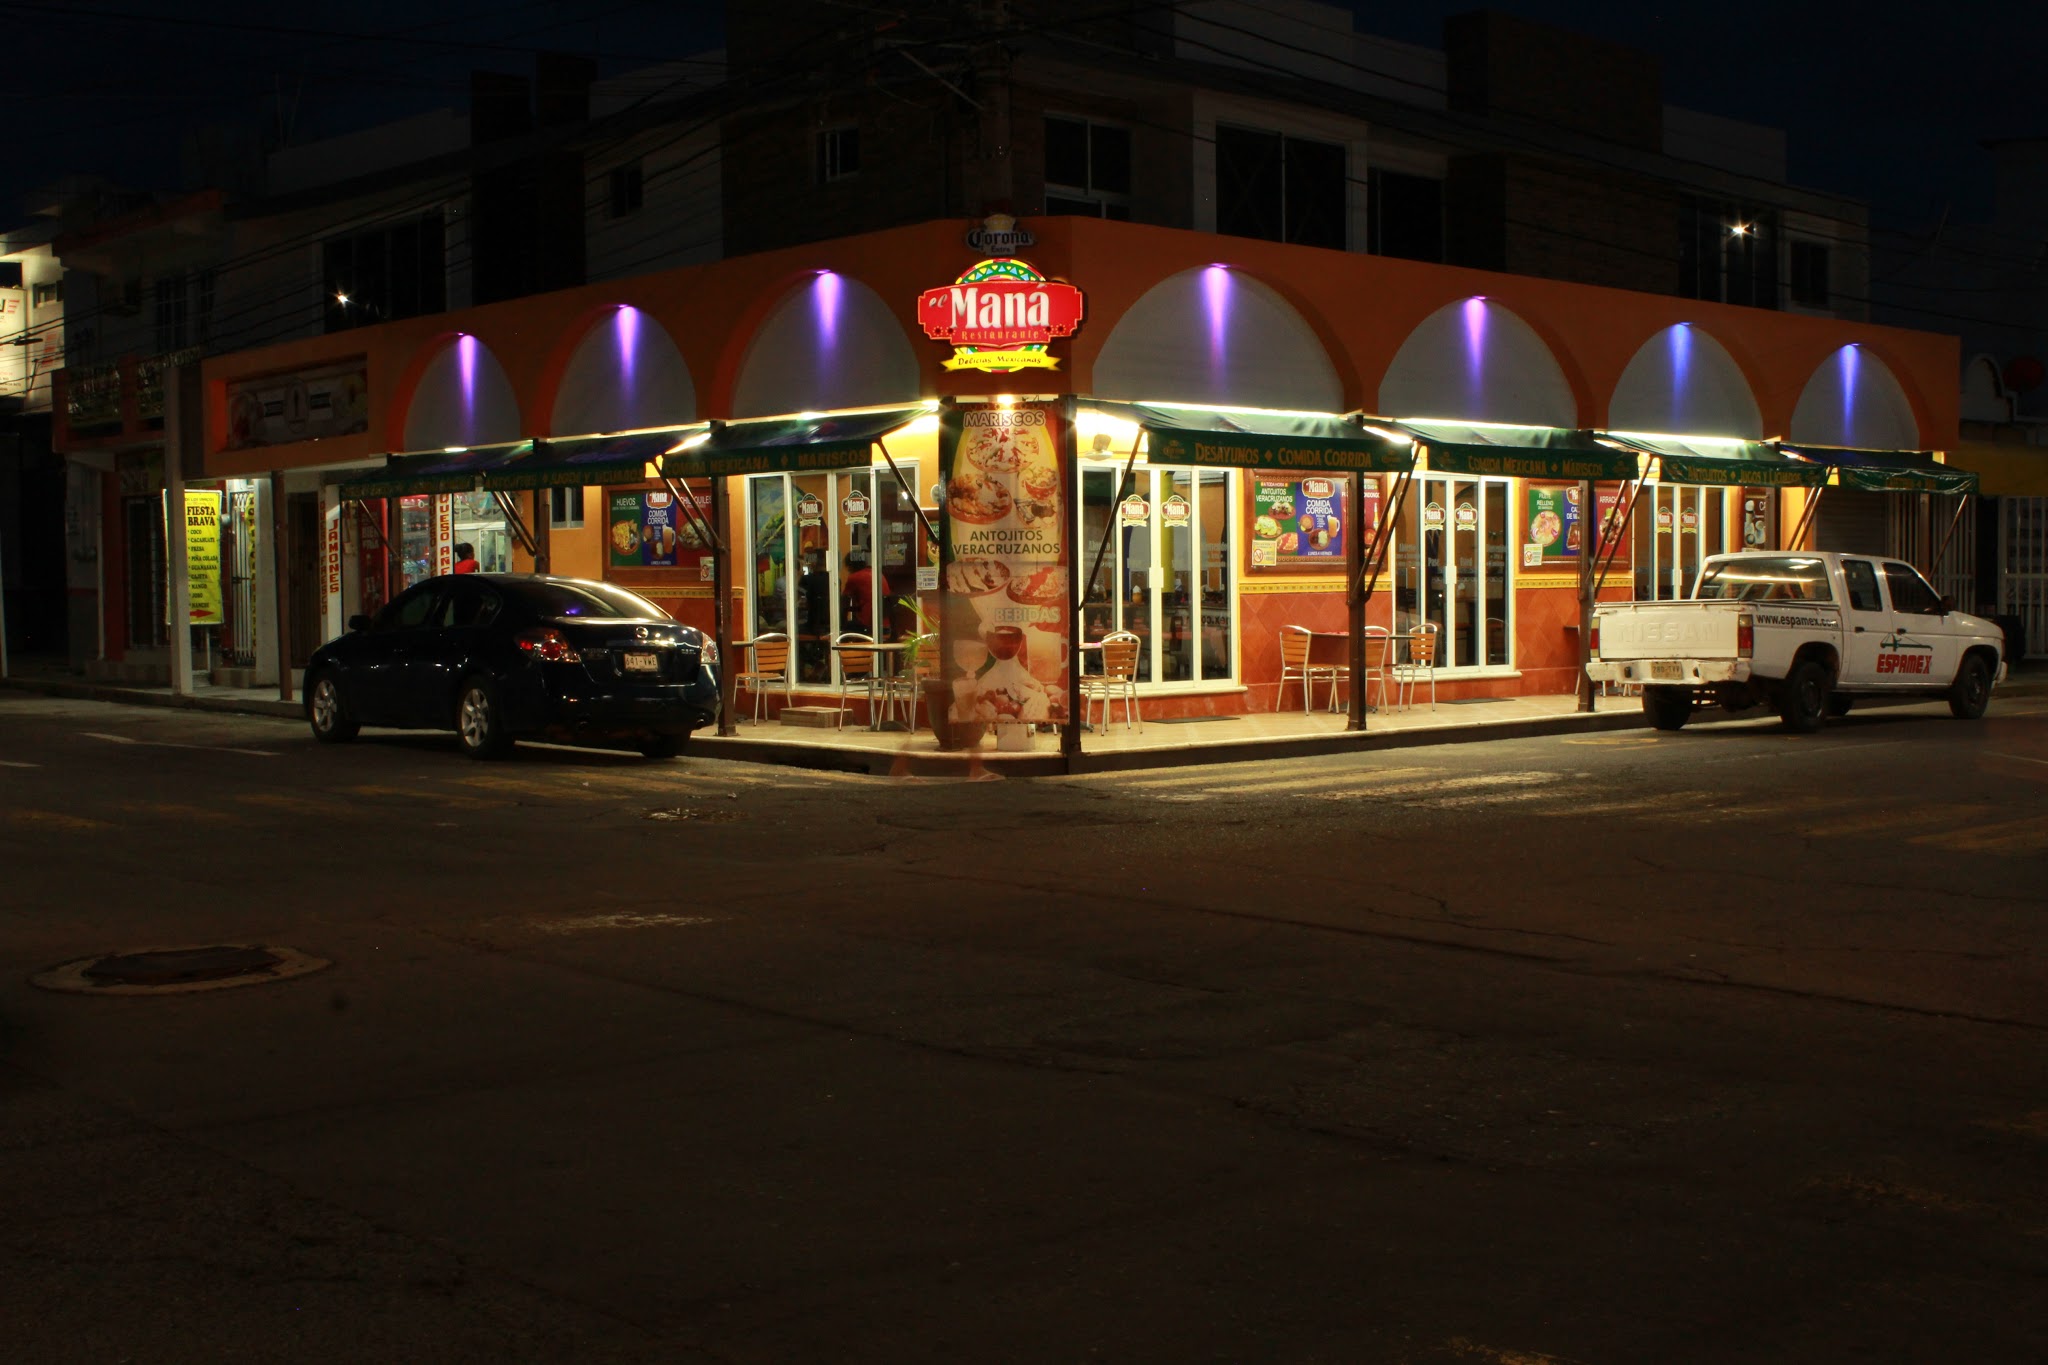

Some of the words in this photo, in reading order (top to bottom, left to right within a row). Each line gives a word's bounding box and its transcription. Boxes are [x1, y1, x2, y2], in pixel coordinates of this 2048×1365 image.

[968, 229, 1030, 249] Corona
[950, 283, 1050, 329] Maná
[961, 330, 1039, 341] Restaurante
[958, 356, 992, 366] Delicias
[996, 354, 1042, 364] Mexicanas
[963, 410, 1046, 428] MARISCOS
[1194, 443, 1260, 464] DESAYUNOS
[1277, 446, 1323, 466] COMIDA
[1323, 448, 1372, 468] CORRIDA
[663, 462, 706, 475] COMIDA
[709, 456, 770, 473] MEXICANA
[798, 449, 868, 468] MARISCOS
[1467, 455, 1502, 472] COMIDA
[1503, 457, 1548, 475] MEXICANA
[1562, 459, 1603, 477] MARISCOS
[1687, 466, 1728, 482] ANTOJITOS
[1739, 469, 1761, 483] JUGOS
[1261, 488, 1287, 496] ANTOJITOS
[1308, 481, 1329, 493] Maná
[616, 497, 636, 506] HUEVOS
[1256, 494, 1294, 503] VERACRUZANOS
[1306, 499, 1331, 507] COMIDA
[187, 506, 216, 516] FIESTA
[648, 509, 668, 517] COMIDA
[1305, 507, 1334, 515] CORRIDA
[188, 516, 216, 527] BRAVA
[647, 517, 669, 525] CORRIDA
[969, 530, 1044, 546] ANTOJITOS
[953, 543, 1061, 555] VERACRUZANOS
[328, 518, 340, 593] JAMONES
[993, 606, 1062, 623] BEBIDAS
[1617, 621, 1720, 643] NISSAN
[1876, 653, 1933, 674] ESPAMEX
